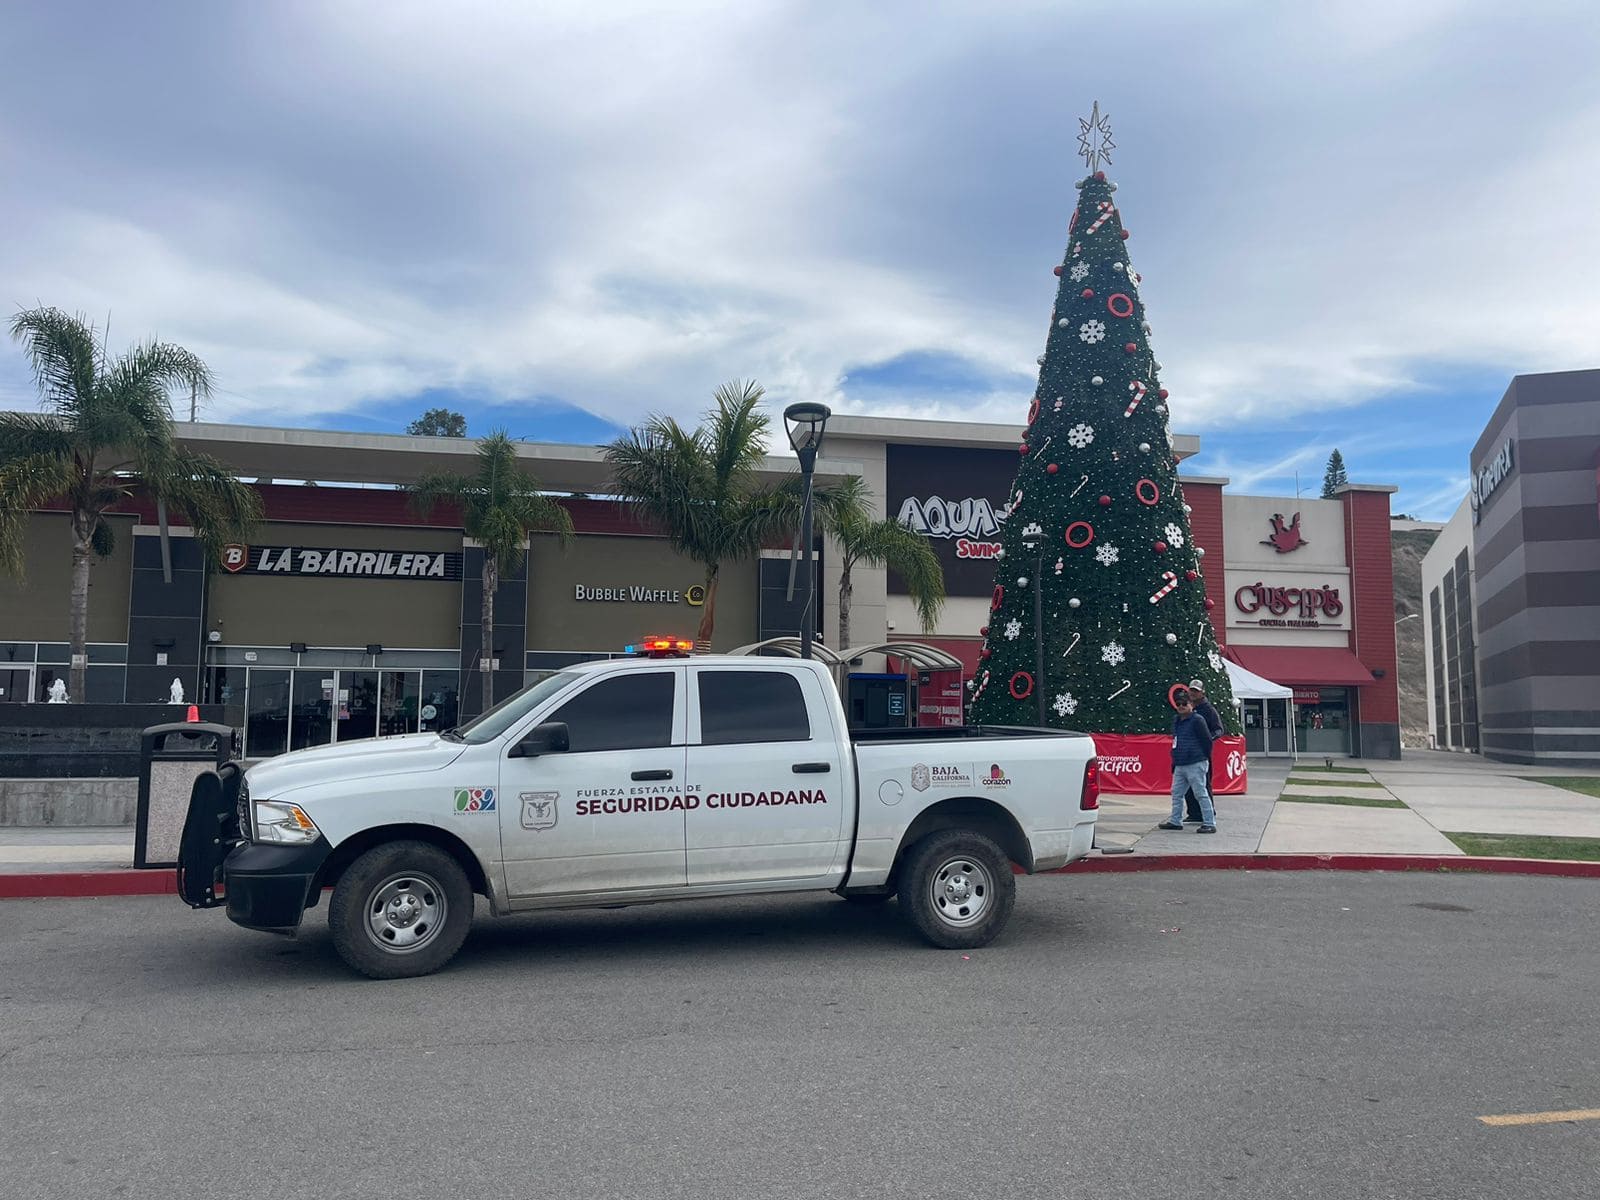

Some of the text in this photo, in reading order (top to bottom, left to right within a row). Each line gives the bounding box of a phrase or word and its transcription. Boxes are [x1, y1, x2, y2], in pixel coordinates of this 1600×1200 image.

[256, 547, 445, 577] LA BARRILERA
[575, 584, 626, 601] BUBBLE
[629, 585, 680, 603] WAFFLE
[931, 766, 960, 776] BAJA
[576, 784, 703, 797] FUERZA ESTATAL DE
[575, 789, 828, 816] SEGURIDAD CIUDADANA
